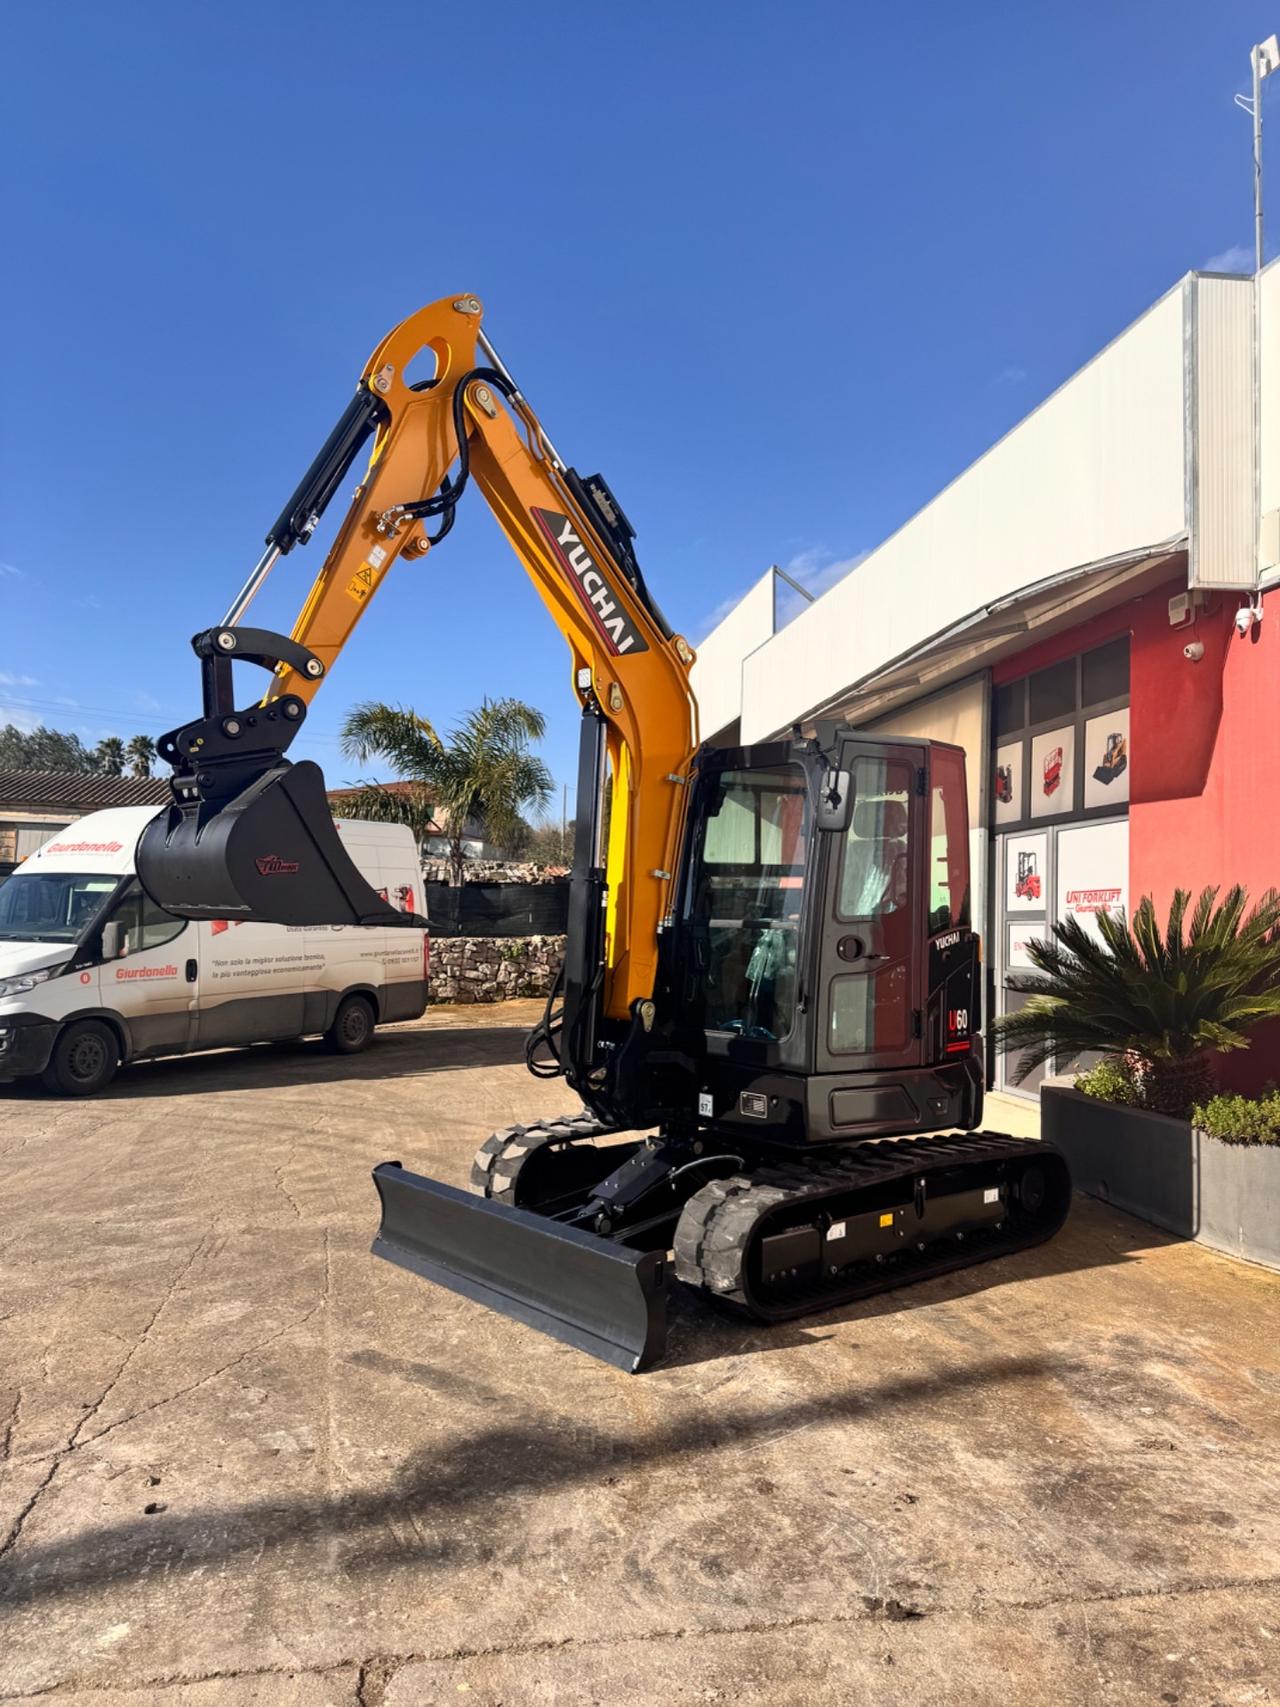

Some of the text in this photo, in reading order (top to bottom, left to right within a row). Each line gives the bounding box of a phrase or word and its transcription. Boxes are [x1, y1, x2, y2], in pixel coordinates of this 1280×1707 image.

[557, 519, 635, 654] YUCHAI
[935, 931, 960, 951] YUCHAI
[116, 965, 177, 979] Giurdanella
[948, 1008, 968, 1031] U60
